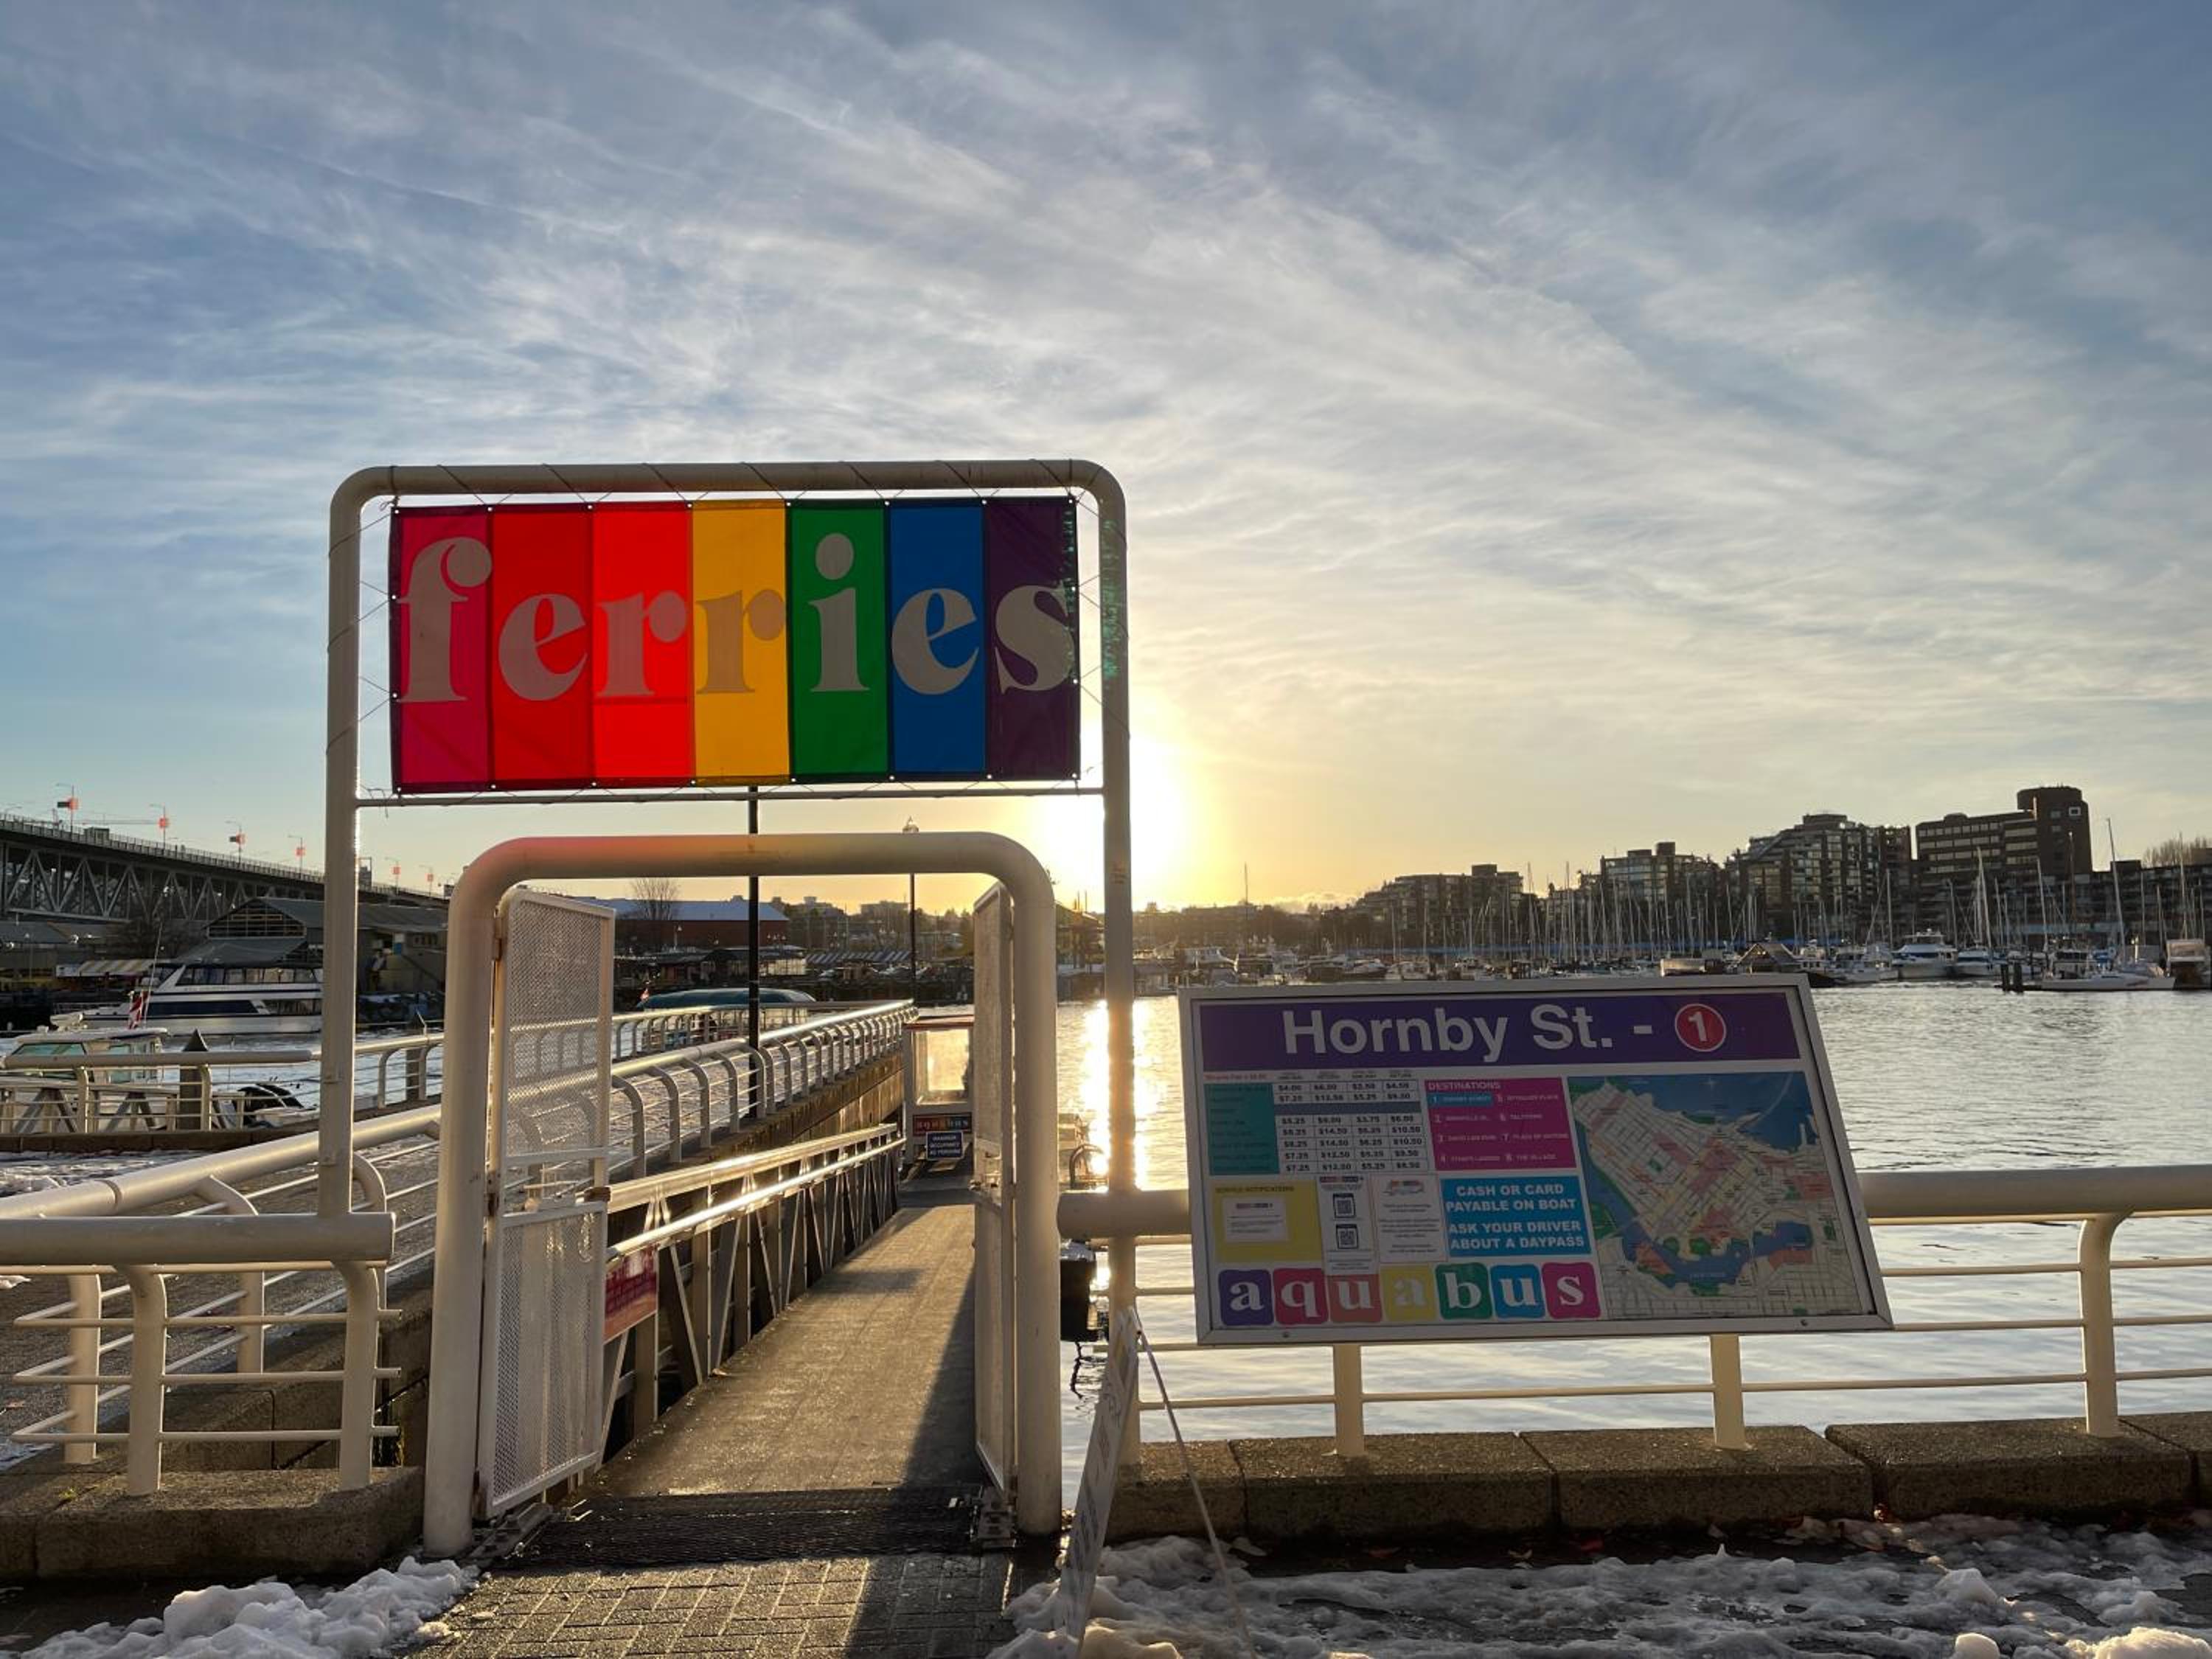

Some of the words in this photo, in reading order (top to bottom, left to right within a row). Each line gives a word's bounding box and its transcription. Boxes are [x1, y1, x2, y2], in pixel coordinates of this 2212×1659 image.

[396, 532, 1077, 703] ferries
[1282, 1007, 1508, 1062] Hornby
[1529, 1004, 1613, 1050] St.
[1427, 1082, 1501, 1091] DESTINATIONS
[1456, 1186, 1495, 1197] CASH
[1500, 1185, 1521, 1195] OR
[1525, 1183, 1564, 1194] CARD
[1446, 1201, 1509, 1212] PAYABLE
[1514, 1200, 1534, 1210] ON
[1539, 1198, 1576, 1209] BOAT
[1449, 1223, 1478, 1234] ASK
[1482, 1222, 1523, 1233] YOUR
[1528, 1220, 1582, 1232] DRIVER
[1450, 1239, 1500, 1250] ABOUT
[1506, 1237, 1515, 1248] A
[1520, 1236, 1585, 1248] DAYPASS
[1228, 1272, 1585, 1319] aquabus
